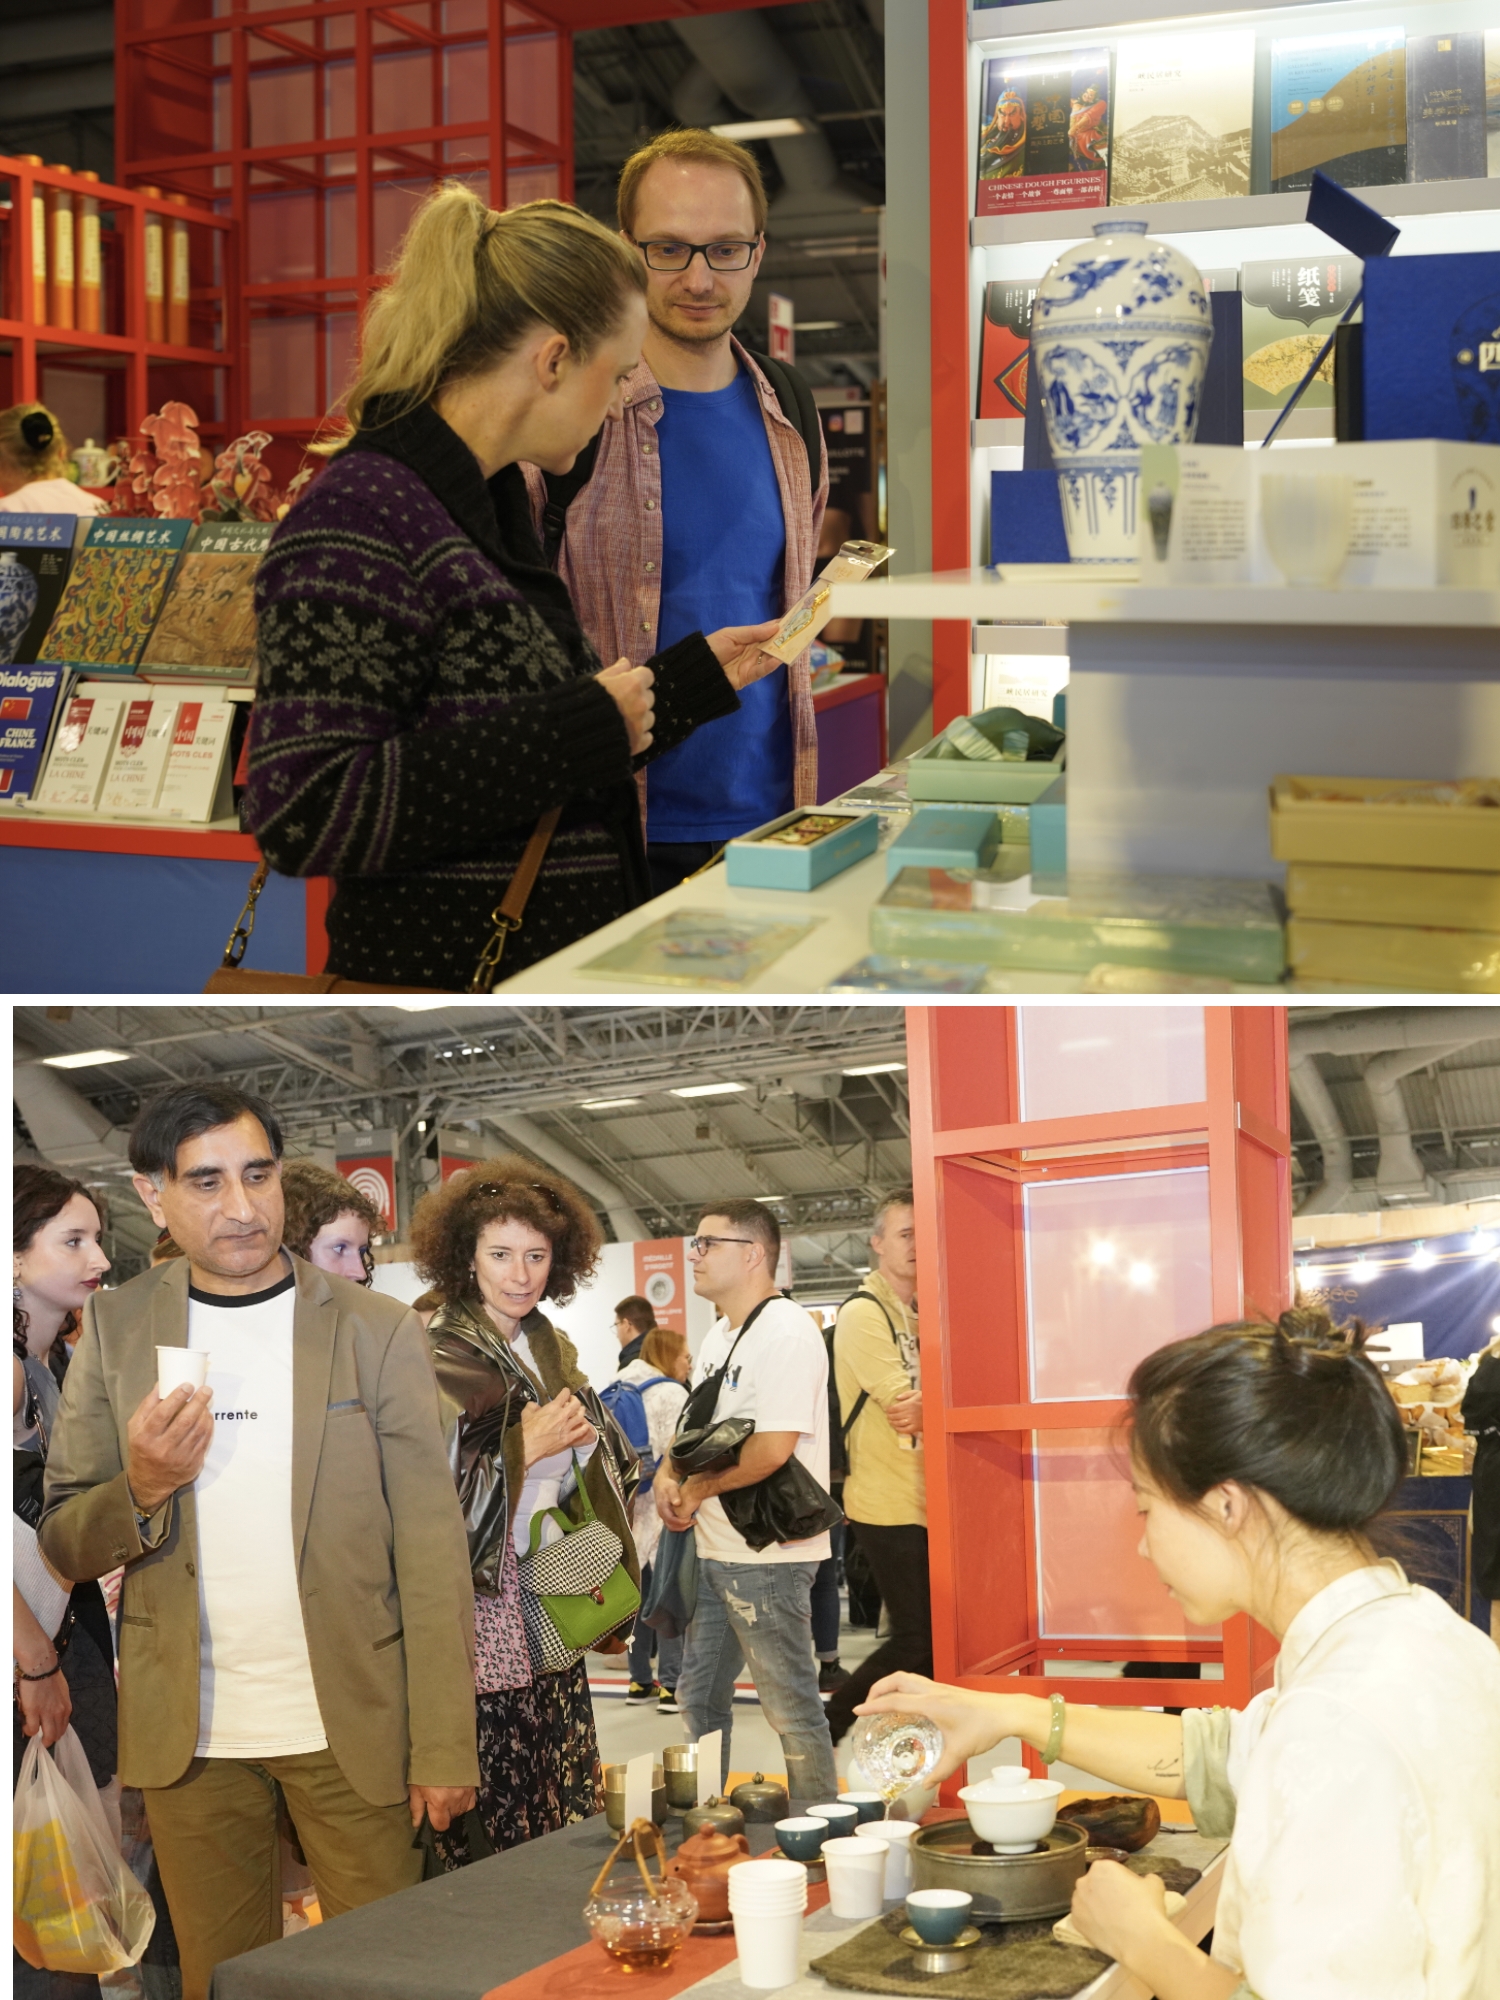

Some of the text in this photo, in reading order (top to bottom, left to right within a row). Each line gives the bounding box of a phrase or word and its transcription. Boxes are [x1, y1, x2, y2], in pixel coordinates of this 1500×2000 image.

[988, 175, 1102, 192] CHINESE DOUGH FIGURINES
[1297, 266, 1321, 307] 纸笺
[93, 527, 173, 544] 中国丝绸艺术
[5, 728, 36, 739] CHINE
[0, 737, 37, 749] FRANCE
[49, 769, 87, 779] LA CHINE
[110, 773, 146, 783] LA CHINE
[214, 1409, 258, 1420] rrente
